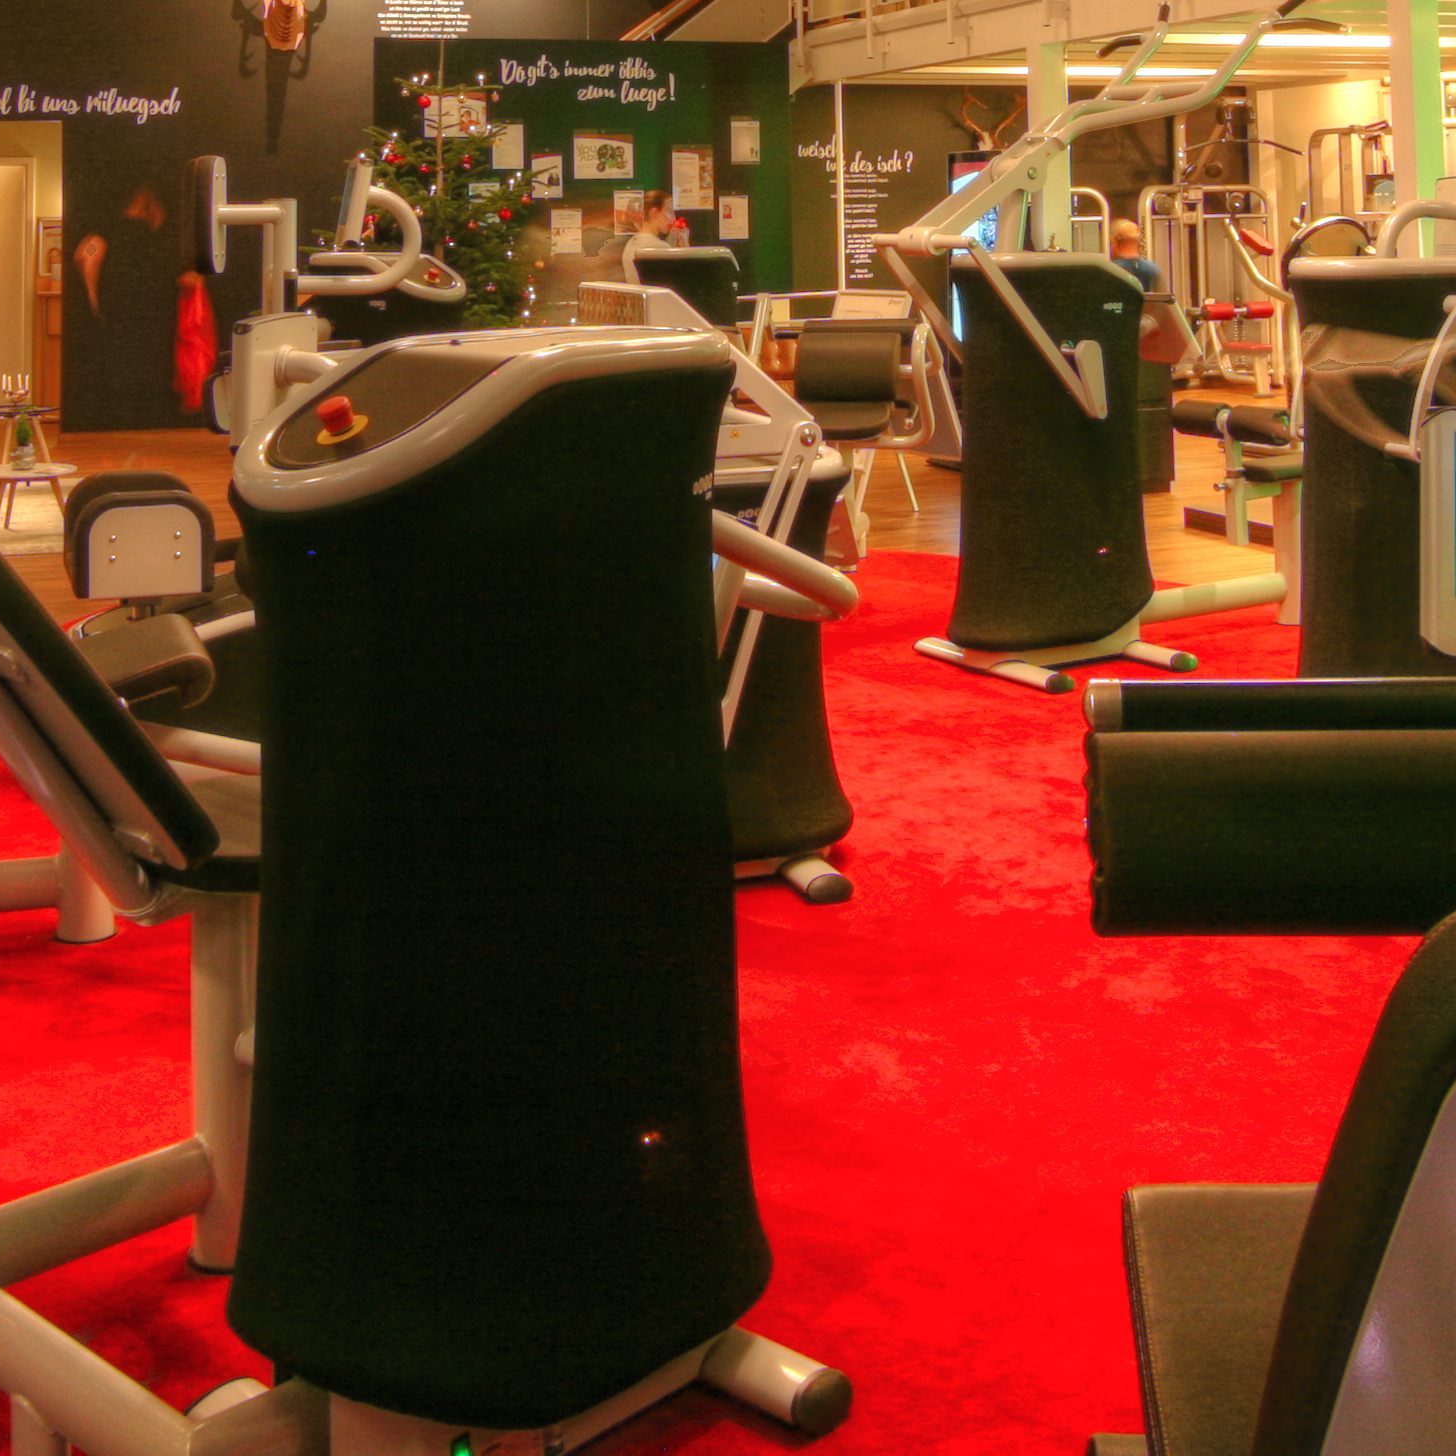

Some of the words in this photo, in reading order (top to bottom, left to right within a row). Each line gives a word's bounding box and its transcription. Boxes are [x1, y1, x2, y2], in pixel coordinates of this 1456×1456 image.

[564, 60, 615, 79] immer
[618, 57, 657, 81] öbbis
[17, 84, 36, 114] bi
[41, 94, 81, 115] uns
[577, 84, 617, 101] zum
[849, 150, 874, 174] des
